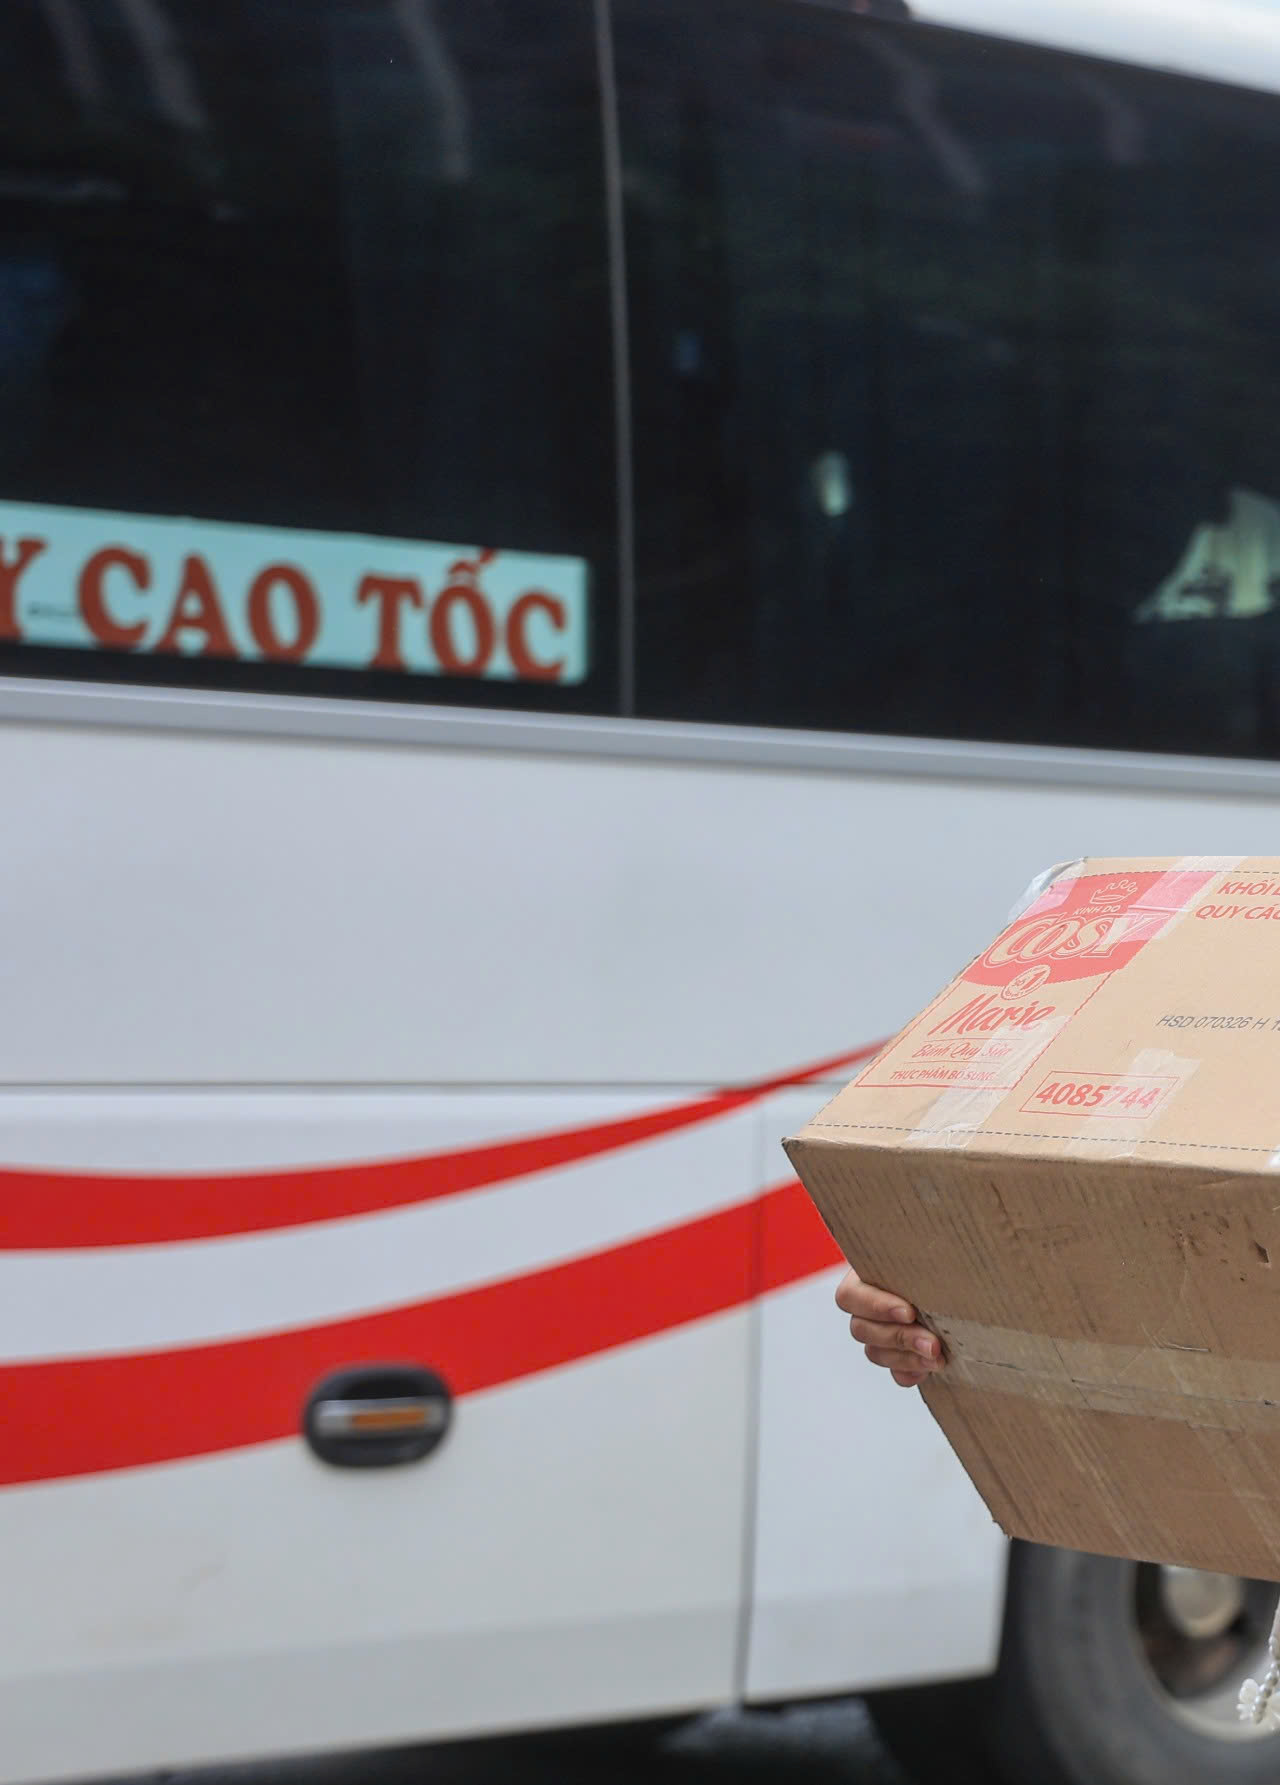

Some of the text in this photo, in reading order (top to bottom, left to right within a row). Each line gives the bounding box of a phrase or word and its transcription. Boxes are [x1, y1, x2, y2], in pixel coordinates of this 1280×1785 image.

[77, 546, 320, 664] CAO
[357, 547, 568, 682] TỐC
[1216, 878, 1276, 896] KHỐI
[1195, 904, 1247, 920] QUY
[983, 913, 1170, 969] COSY
[927, 993, 1057, 1036] Marie
[1156, 1015, 1195, 1029] HSD
[1194, 1016, 1253, 1029] 070326
[1251, 1017, 1271, 1030] H
[950, 1042, 983, 1060] Quy
[1035, 1081, 1163, 1110] 4085744
